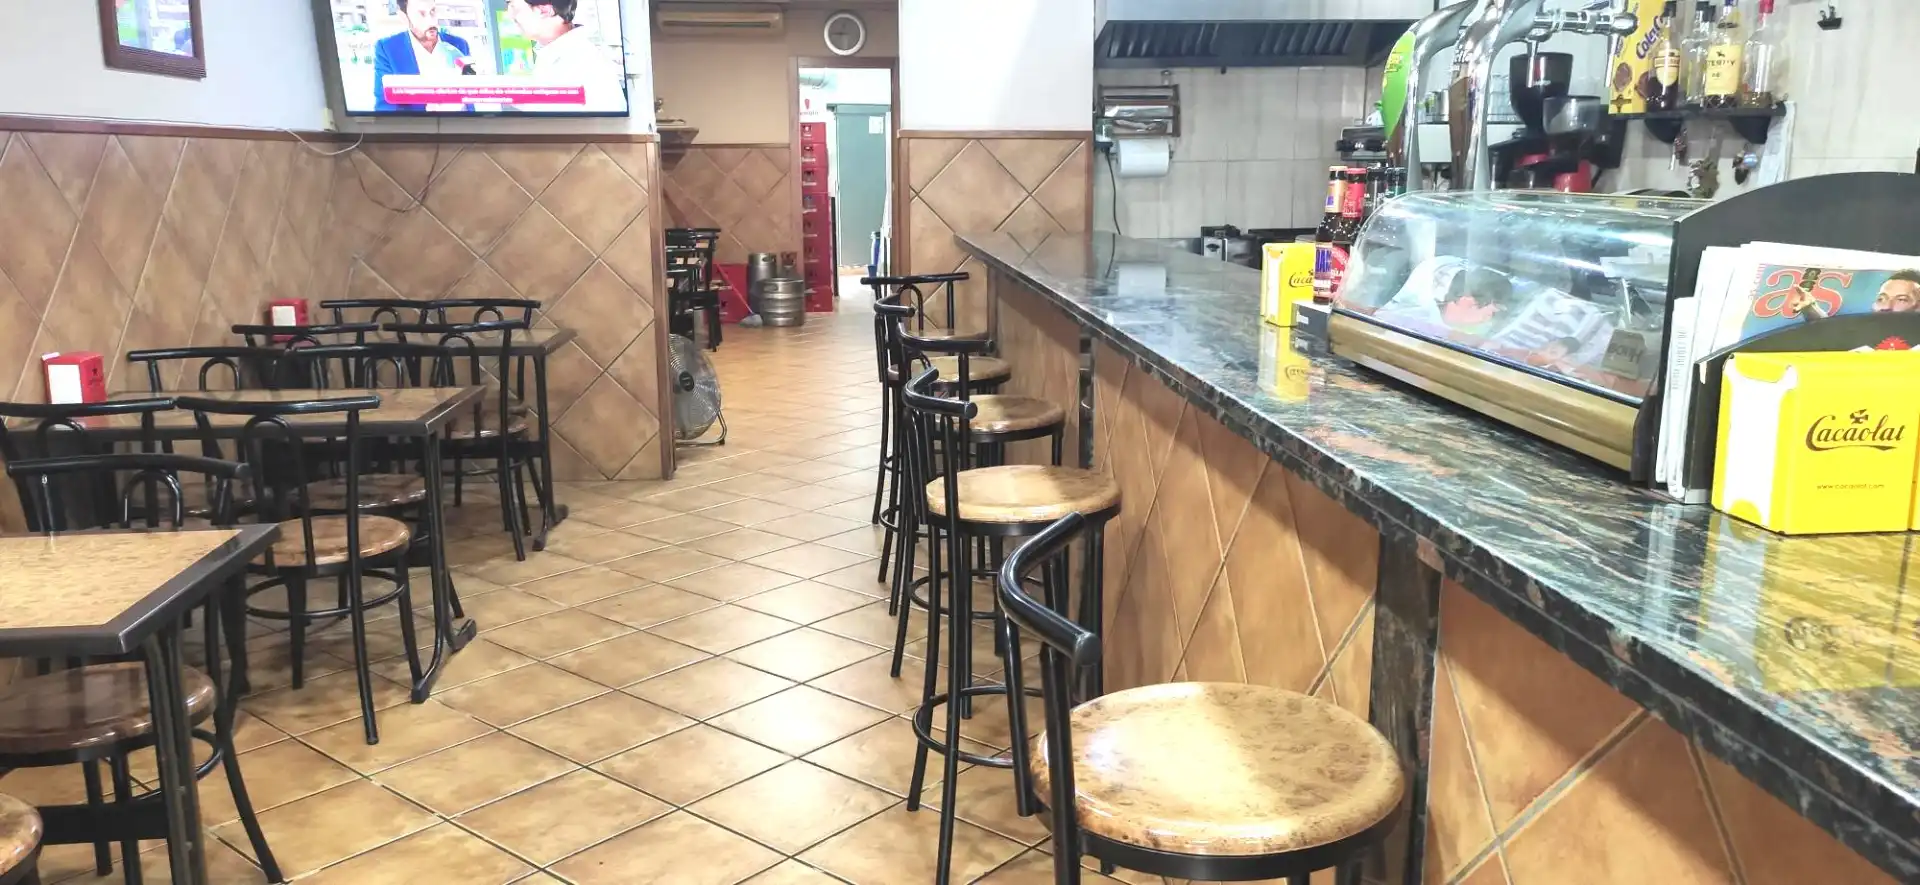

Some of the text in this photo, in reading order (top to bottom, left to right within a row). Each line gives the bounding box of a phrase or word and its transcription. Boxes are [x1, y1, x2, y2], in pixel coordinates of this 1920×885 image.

[1289, 271, 1313, 288] Caca
[1752, 266, 1854, 319] as
[1805, 413, 1906, 452] Cacaolat
